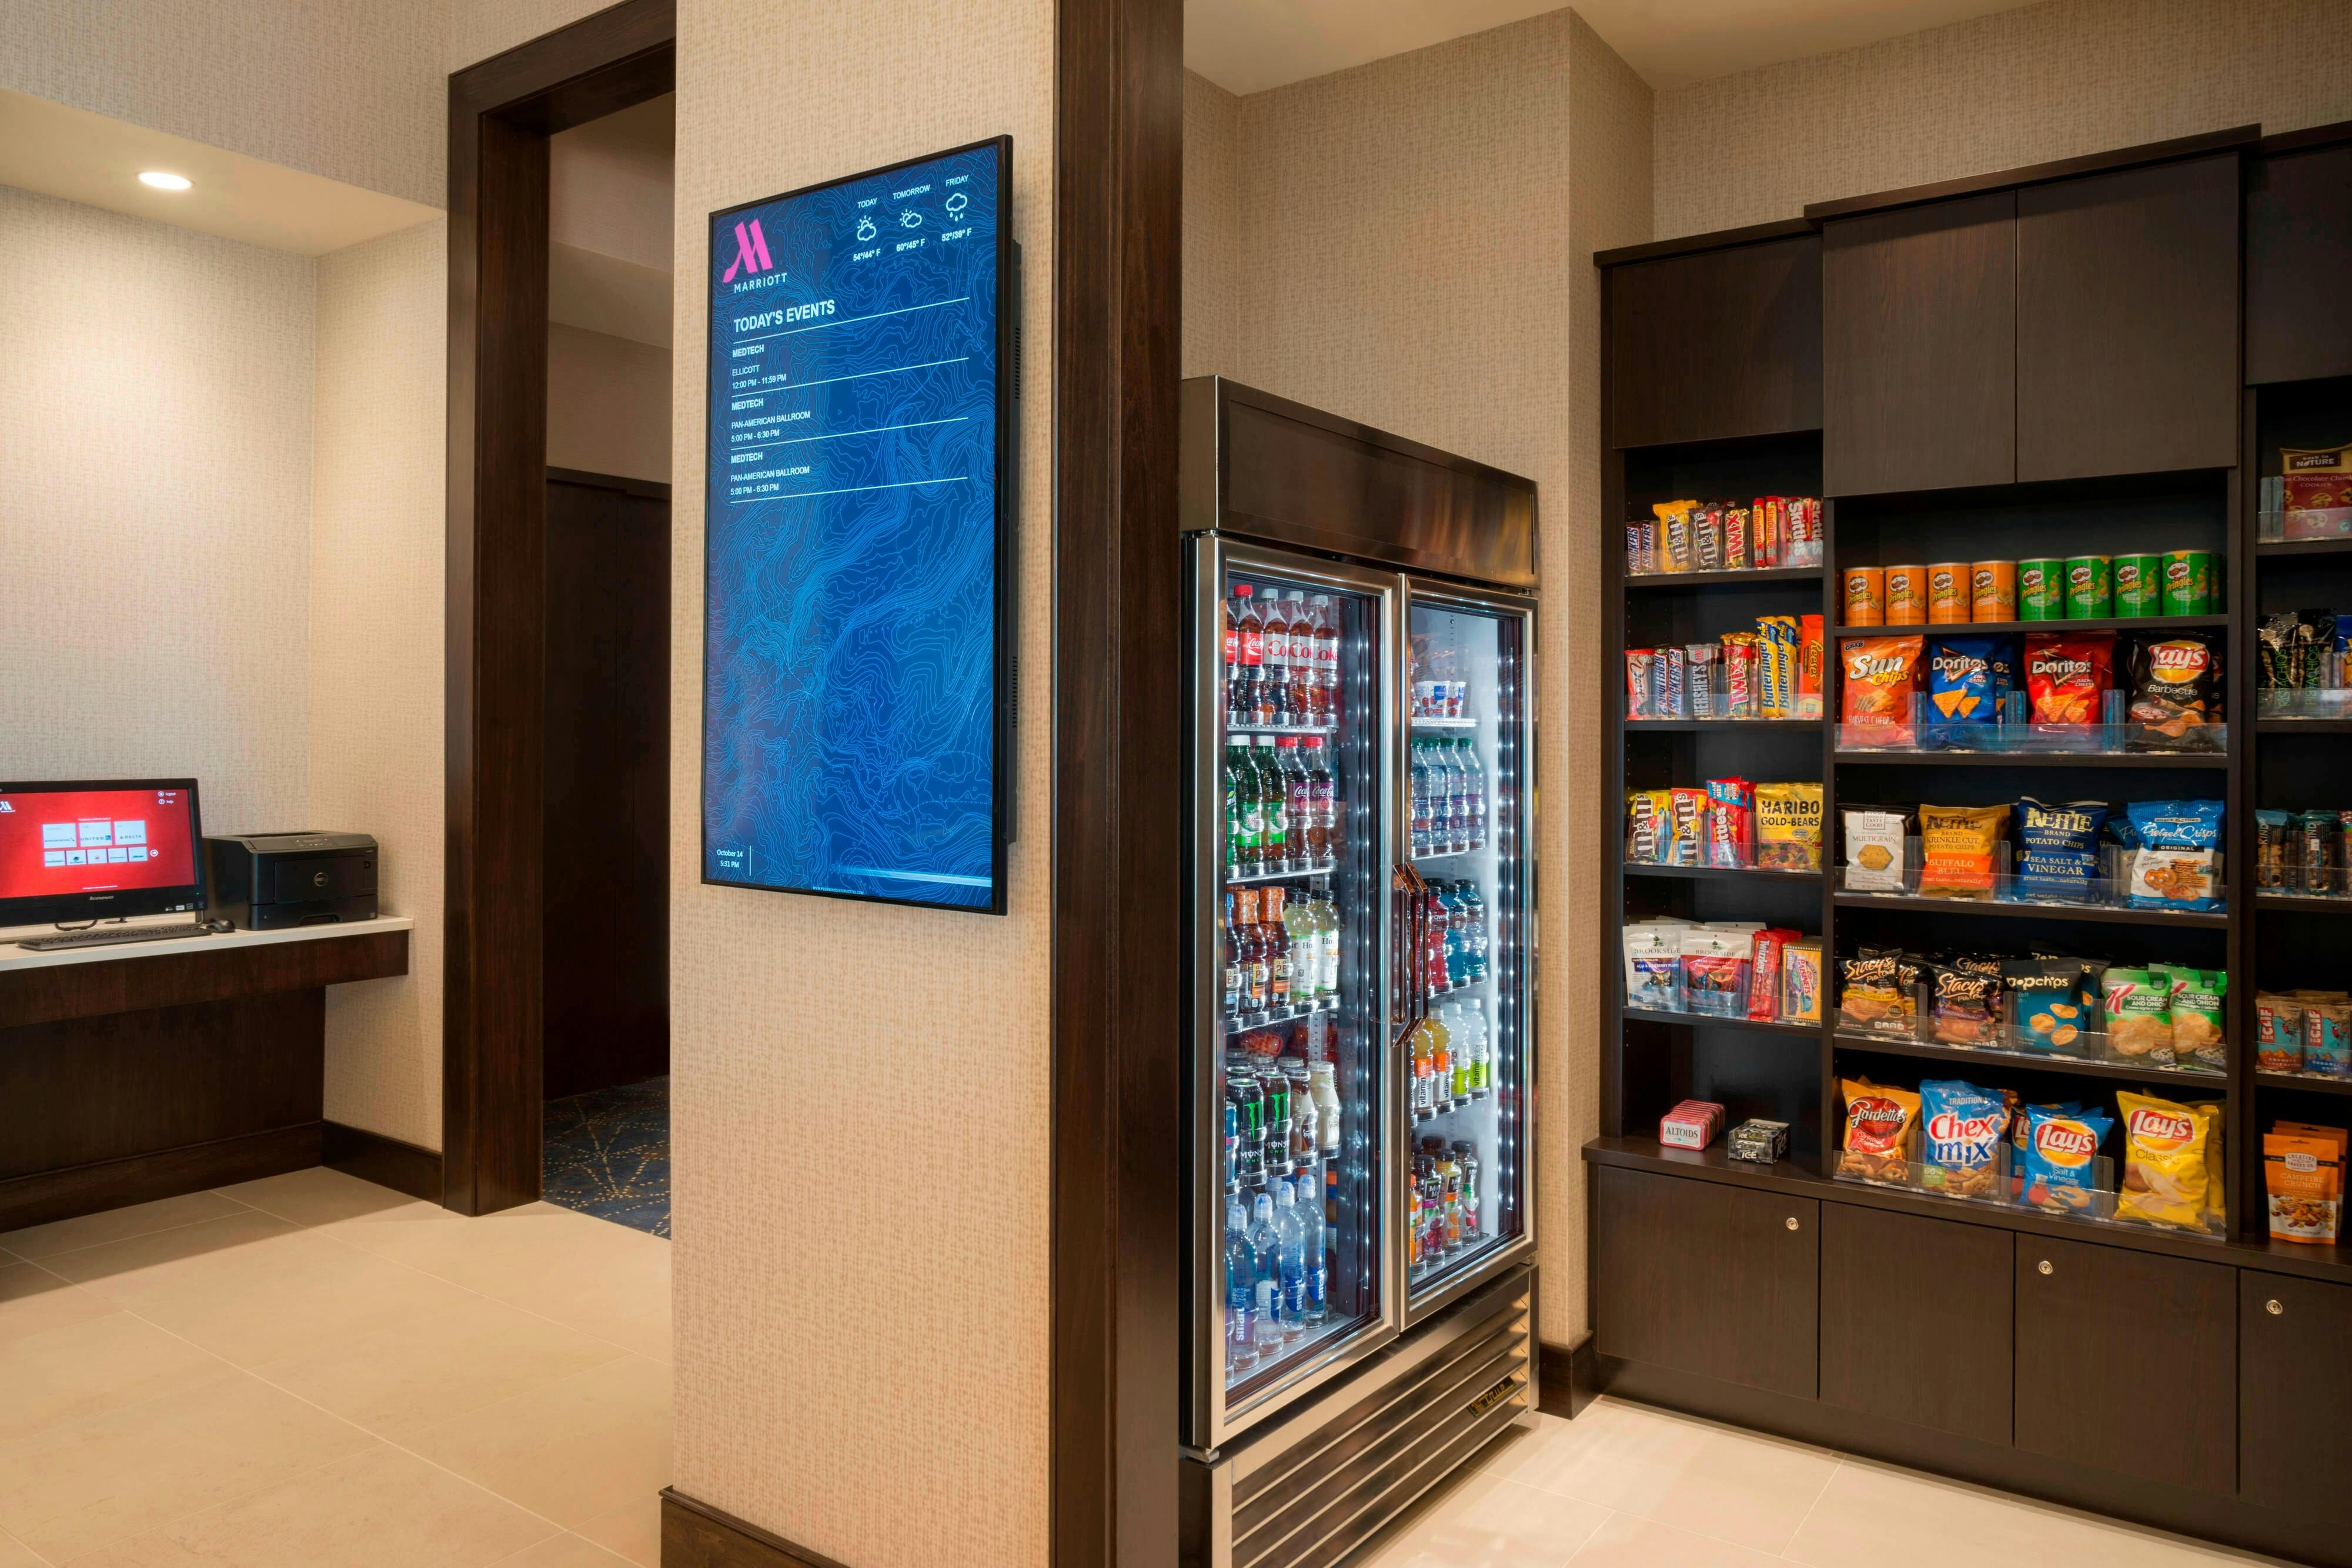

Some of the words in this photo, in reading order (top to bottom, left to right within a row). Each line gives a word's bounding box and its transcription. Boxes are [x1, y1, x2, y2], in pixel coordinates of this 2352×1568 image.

[946, 175, 969, 186] FRIDAY
[893, 185, 930, 199] TOMORROW
[857, 198, 877, 208] TODAY
[967, 228, 972, 236] F
[919, 239, 926, 247] F
[876, 249, 881, 257] F
[734, 272, 787, 293] MARRIOTT
[734, 310, 783, 332] TODAY'S
[787, 300, 835, 322] EVENTS
[733, 345, 764, 357] MEDTECH
[732, 365, 760, 376] ELLICOTT
[732, 381, 746, 389] 12:00
[761, 376, 776, 385] 11:59
[777, 374, 786, 382] PM
[731, 398, 763, 410] MEDTECH
[731, 416, 776, 429] PAN-AMERICAN
[777, 411, 810, 423] BALLROOM
[731, 434, 743, 442] 5:00
[744, 432, 753, 441] PM
[757, 430, 769, 439] 6:30
[770, 429, 780, 437] PM
[731, 452, 763, 464] MEDTECH
[731, 470, 774, 482] PAN-AMERICAN
[776, 466, 810, 477] BALLROOM
[743, 486, 752, 494] PM
[757, 484, 769, 493] 6:30
[770, 483, 779, 492] PM
[1628, 528, 1639, 570] SNICKERS
[1643, 524, 1652, 568] SNICKERS
[2022, 583, 2046, 599] Pringles
[2070, 581, 2095, 599] Pringles
[2117, 580, 2141, 596] Pringles
[2167, 577, 2193, 593] Pringles
[1847, 591, 1871, 607] Pringles
[1889, 590, 1913, 606] Pringles
[1932, 588, 1957, 605] Pringles
[1973, 585, 1997, 601] Pringles
[1933, 657, 1989, 671] Doritos
[2153, 647, 2206, 669] Lay's
[1849, 654, 1904, 680] Sun
[2032, 660, 2092, 674] Doritos
[1669, 663, 1682, 713] SNICKERS
[1693, 664, 1709, 716] HERSHEY'S
[2147, 684, 2197, 696] Barbecue
[1762, 800, 1820, 814] HARIBO
[1761, 817, 1819, 826] GOLD-BEARS
[2062, 840, 2084, 849] CHIPS
[1929, 859, 1975, 867] BUFFALO
[2027, 864, 2084, 875] VINEGAR
[1845, 957, 1893, 981] Stacy's
[1935, 973, 1988, 998] Stacy's
[2006, 976, 2069, 990] popchips
[2260, 1009, 2273, 1035] CLIF
[2308, 1010, 2321, 1038] CLIF
[1665, 1126, 1698, 1139] ALTOIDS
[1930, 1114, 1995, 1140] Chex
[2133, 1111, 2189, 1139] Lay's
[2040, 1125, 2093, 1154] Lay's
[1937, 1138, 1991, 1165] mix
[2136, 1149, 2180, 1165] Classic
[2049, 1172, 2079, 1185] Vinegar
[2053, 1167, 2069, 1175] Salt
[2281, 1173, 2324, 1183] CAMPFIRE
[2284, 1180, 2321, 1188] CRUNCH
